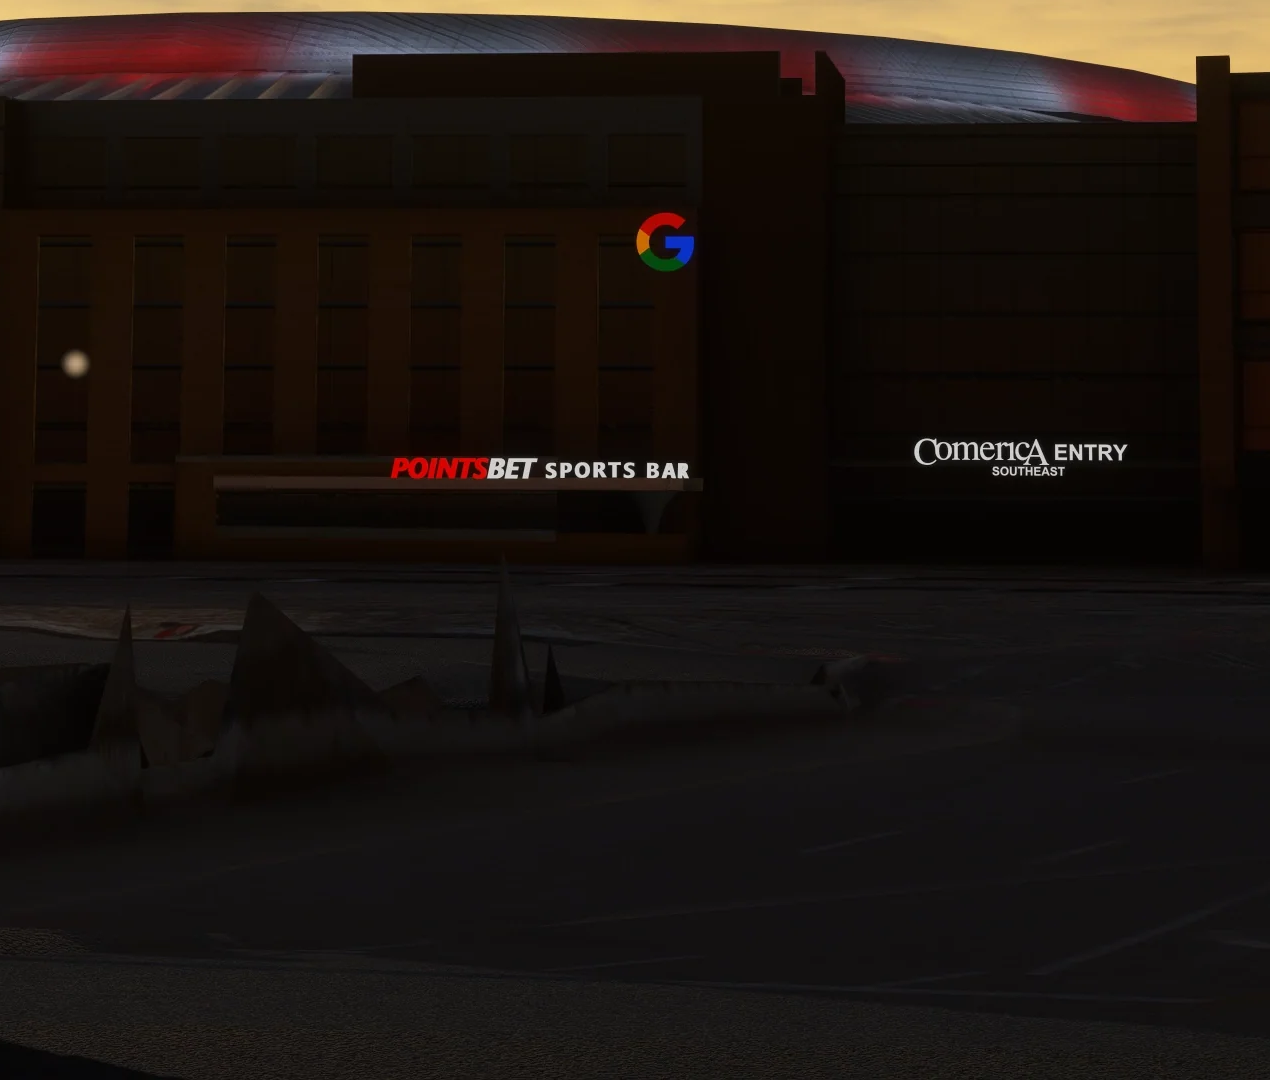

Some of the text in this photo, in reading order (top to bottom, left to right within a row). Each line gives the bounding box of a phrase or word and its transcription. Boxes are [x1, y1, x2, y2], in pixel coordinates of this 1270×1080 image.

[636, 212, 695, 272] G
[1054, 443, 1128, 462] ENTRY
[390, 457, 690, 479] POINTSBET SPORTS BAR
[991, 465, 1065, 477] SOUTHEAST
